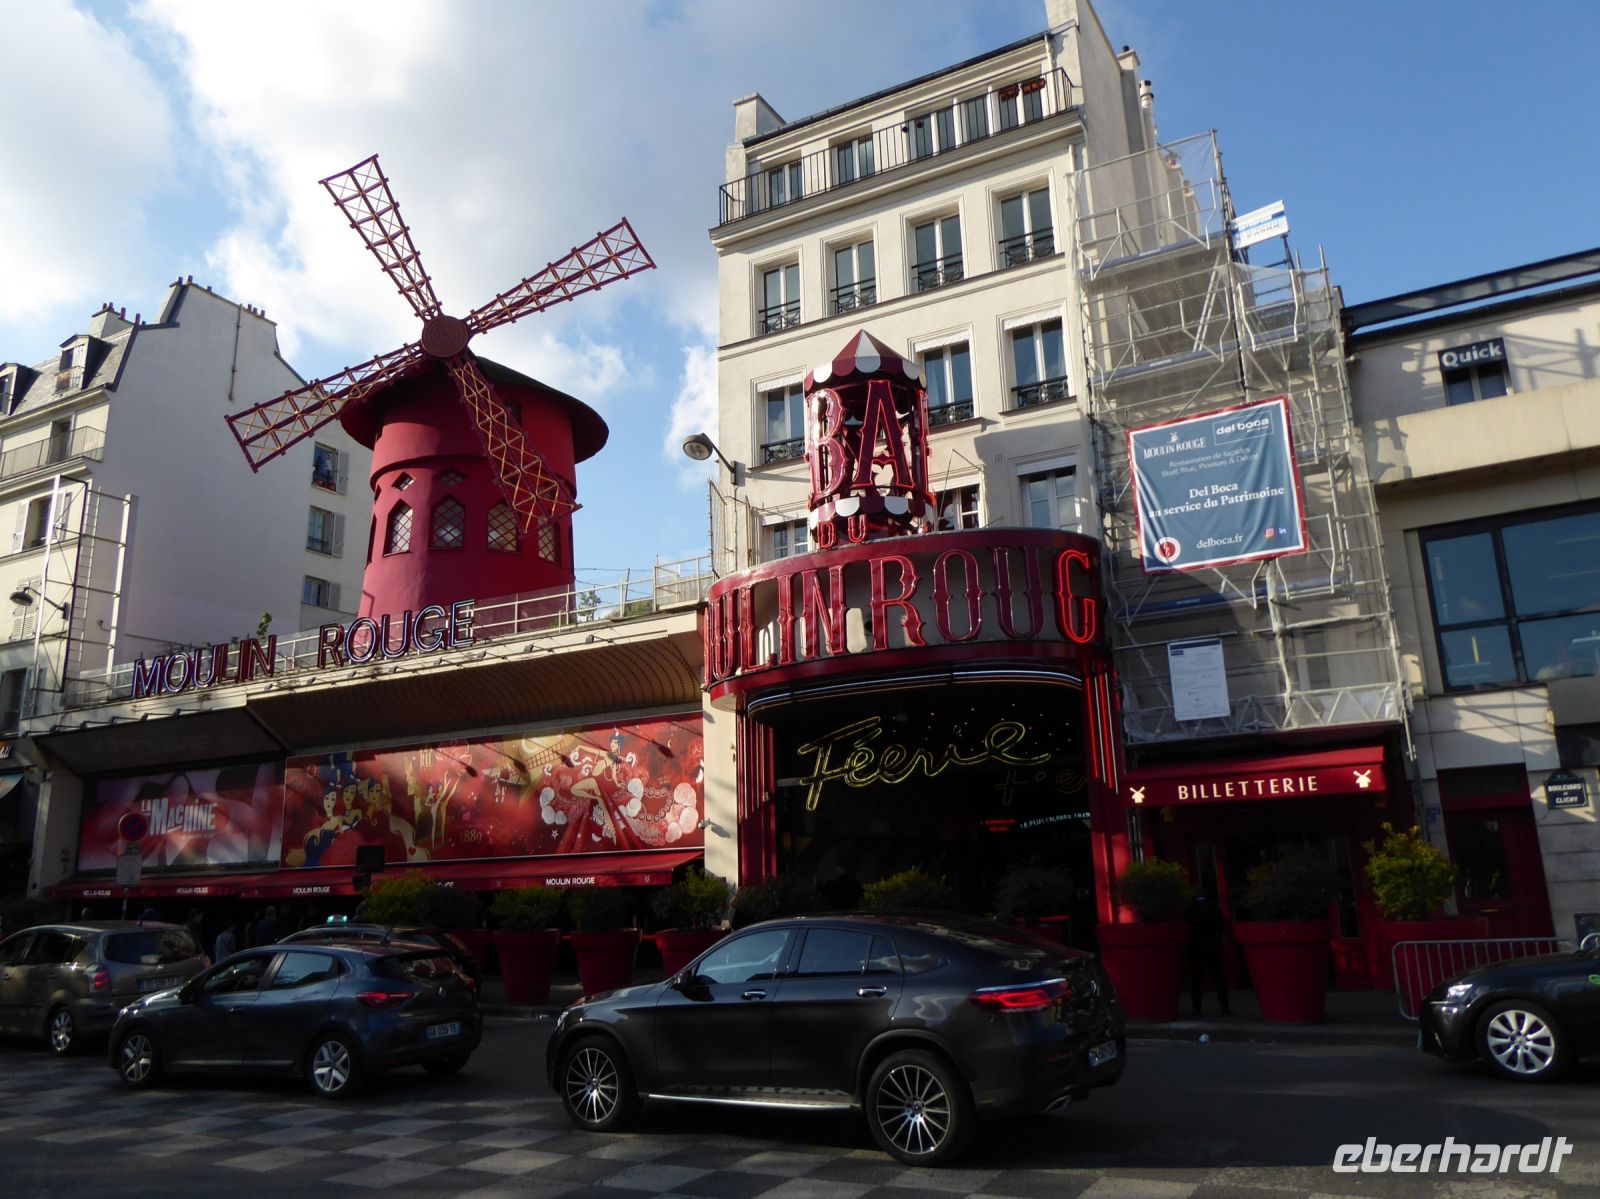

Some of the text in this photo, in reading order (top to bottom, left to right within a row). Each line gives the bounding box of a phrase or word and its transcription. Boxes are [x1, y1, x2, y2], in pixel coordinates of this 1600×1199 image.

[1441, 342, 1503, 367] Quick
[1216, 424, 1235, 435] del
[1237, 417, 1269, 431] boca
[1143, 437, 1206, 459] MOULIN ROUGE
[1163, 502, 1201, 516] service
[1204, 498, 1218, 508] du
[1221, 486, 1285, 505] Patrimoine
[1189, 482, 1238, 499] Del Boca
[817, 515, 867, 549] DU
[1197, 533, 1244, 549] delboca.fr
[704, 565, 847, 686] ULIN
[131, 599, 475, 699] MOULIN ROUGE
[1178, 776, 1318, 800] BILLETTERIE
[460, 828, 482, 843] 1889
[546, 877, 595, 886] MOULIN ROUGE
